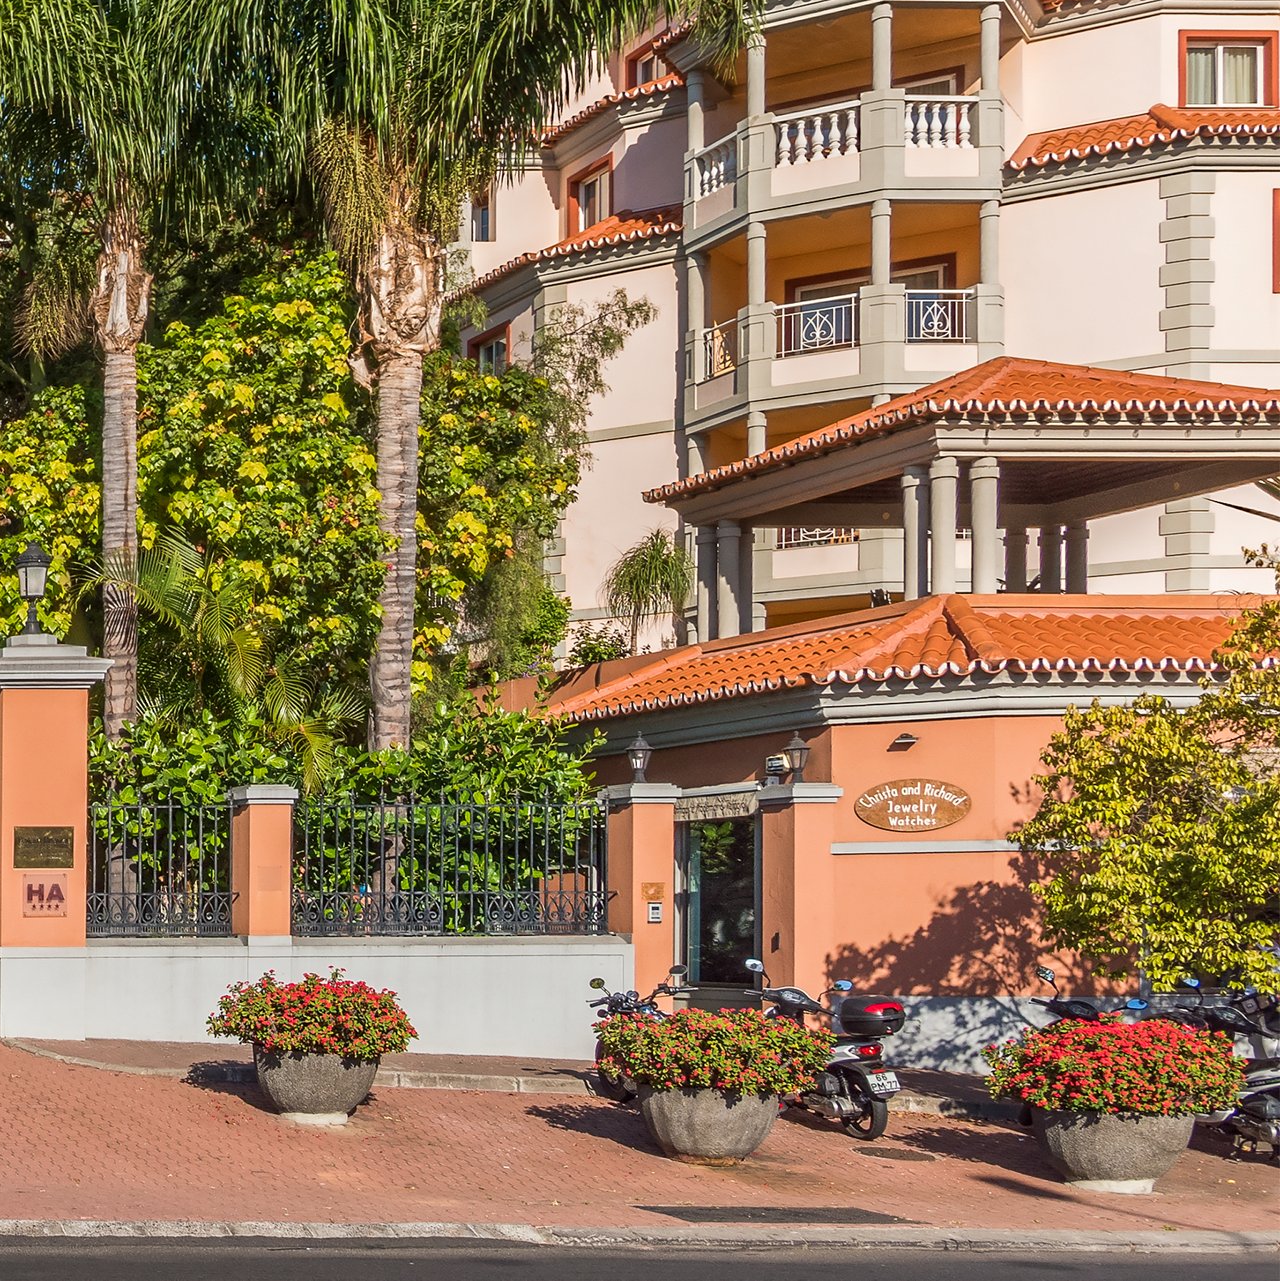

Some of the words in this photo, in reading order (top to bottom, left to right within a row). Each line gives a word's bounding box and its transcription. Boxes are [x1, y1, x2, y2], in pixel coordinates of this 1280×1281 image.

[859, 785, 898, 808] Christa
[901, 782, 921, 796] and
[924, 783, 967, 807] Richard
[887, 799, 938, 815] Jewelry
[888, 816, 937, 826] Watches
[27, 883, 65, 903] HA
